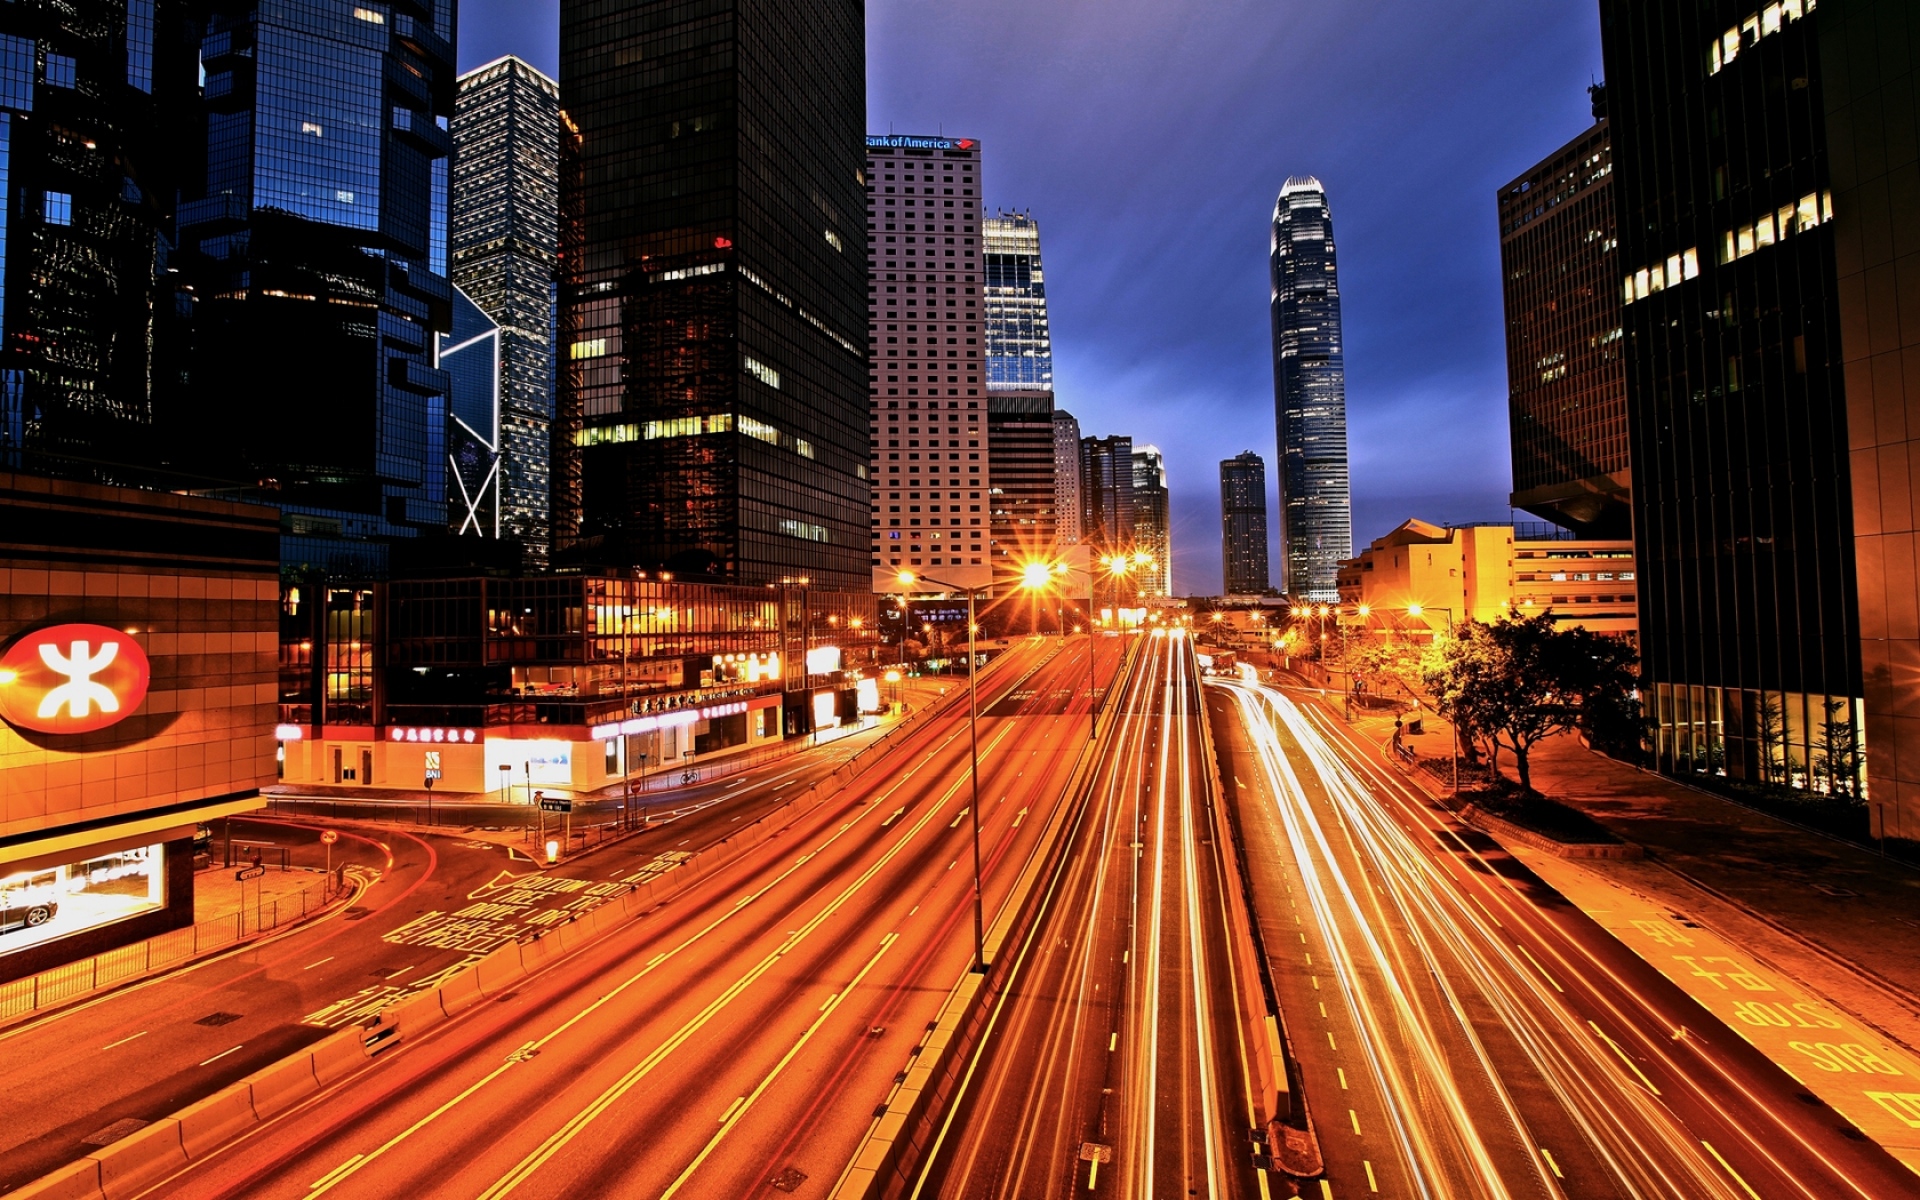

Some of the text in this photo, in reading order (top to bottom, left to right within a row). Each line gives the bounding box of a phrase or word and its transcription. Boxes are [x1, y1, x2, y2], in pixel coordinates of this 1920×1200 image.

[891, 137, 902, 147] of
[904, 137, 950, 149] America
[425, 770, 441, 778] BNI
[513, 876, 593, 893] COTTON
[492, 889, 557, 906] TREE
[451, 902, 530, 921] DRIVE
[1672, 955, 1776, 991] 巴士
[1733, 1000, 1843, 1030] STOP
[1787, 1041, 1904, 1075] BUS
